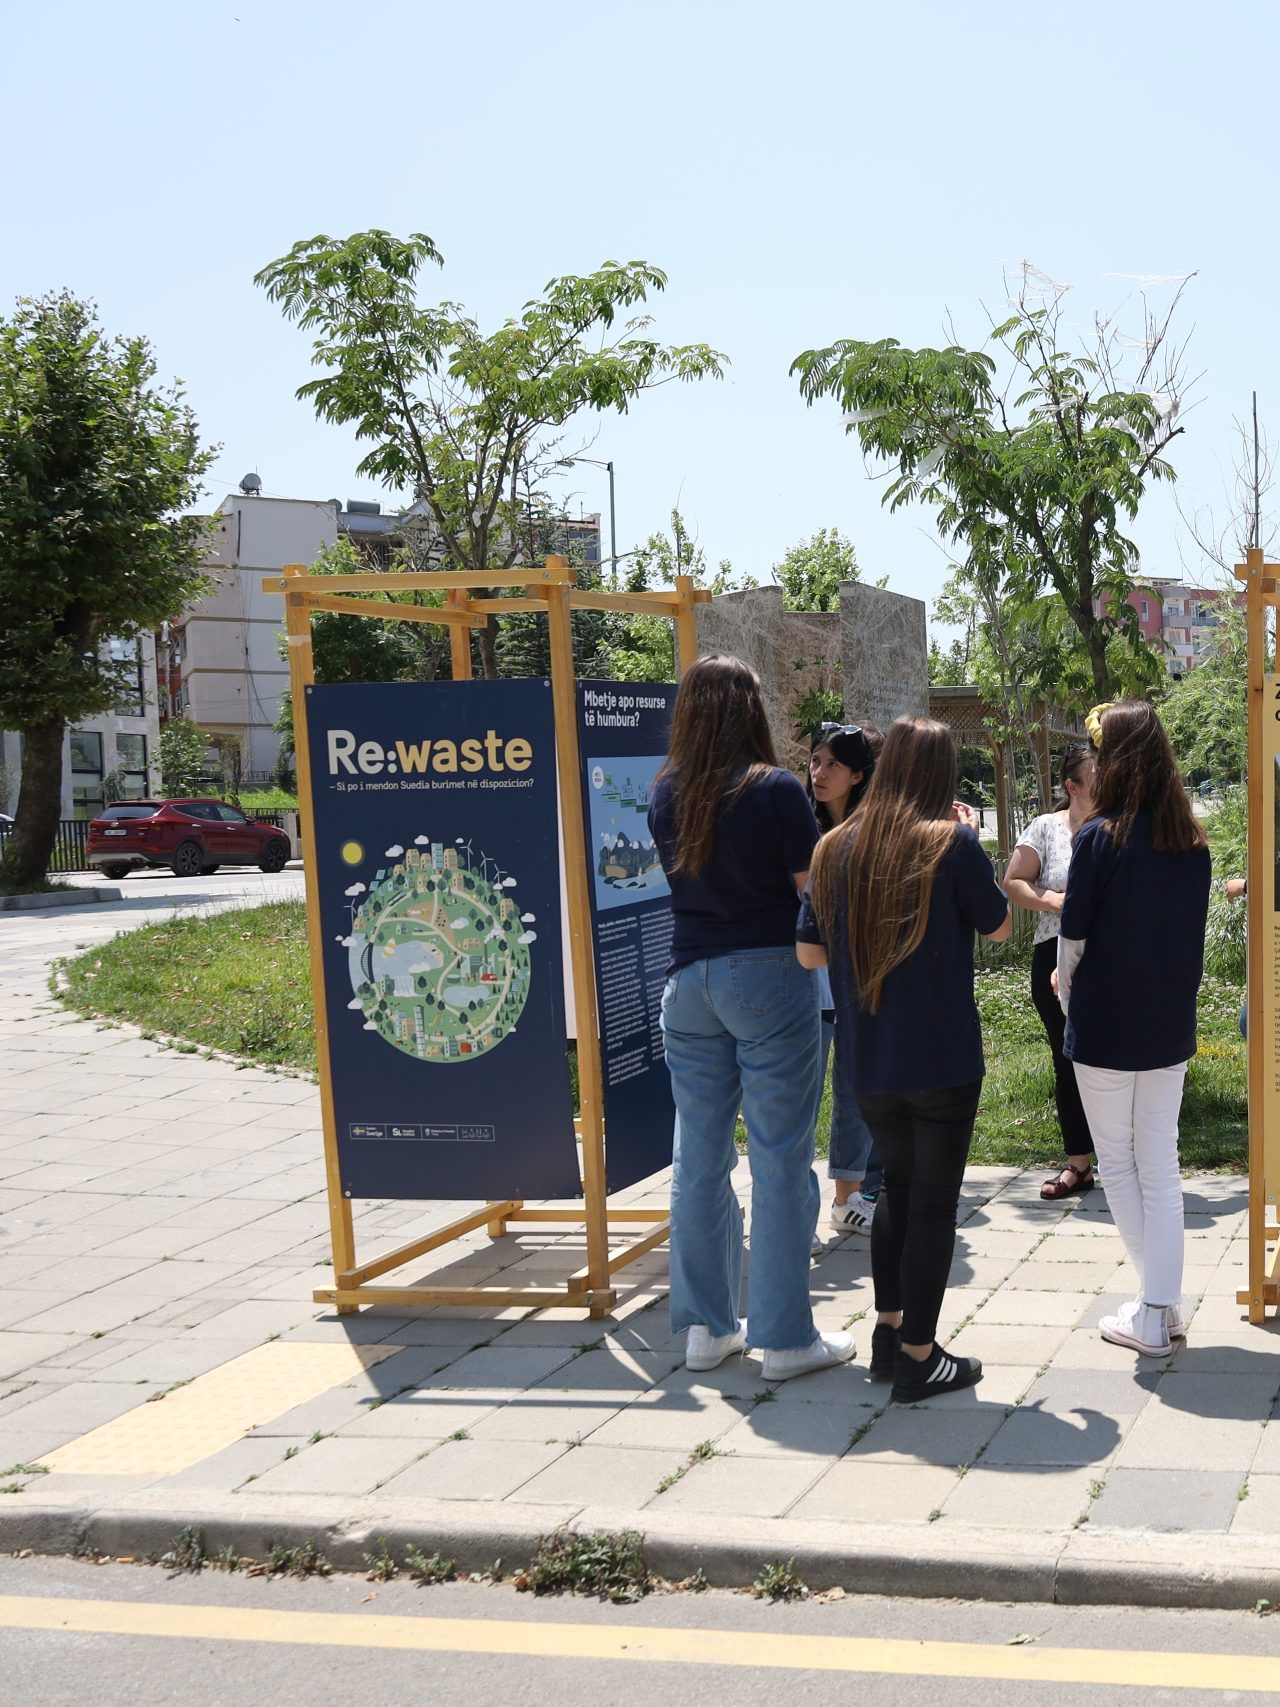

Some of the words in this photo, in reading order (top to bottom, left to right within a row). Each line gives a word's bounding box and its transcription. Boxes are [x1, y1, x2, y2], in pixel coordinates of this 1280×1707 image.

[584, 690, 617, 711] Mbetje
[618, 695, 635, 712] apo
[635, 696, 666, 709] resurse
[584, 709, 596, 727] të
[597, 710, 640, 727] humbura?
[327, 729, 533, 775] Re:waste
[336, 781, 346, 791] Si
[347, 783, 359, 792] po
[365, 781, 399, 790] mendon
[400, 780, 430, 790] Suedia
[431, 779, 465, 789] burimet
[467, 779, 478, 788] në
[479, 778, 534, 790] dispozicion?
